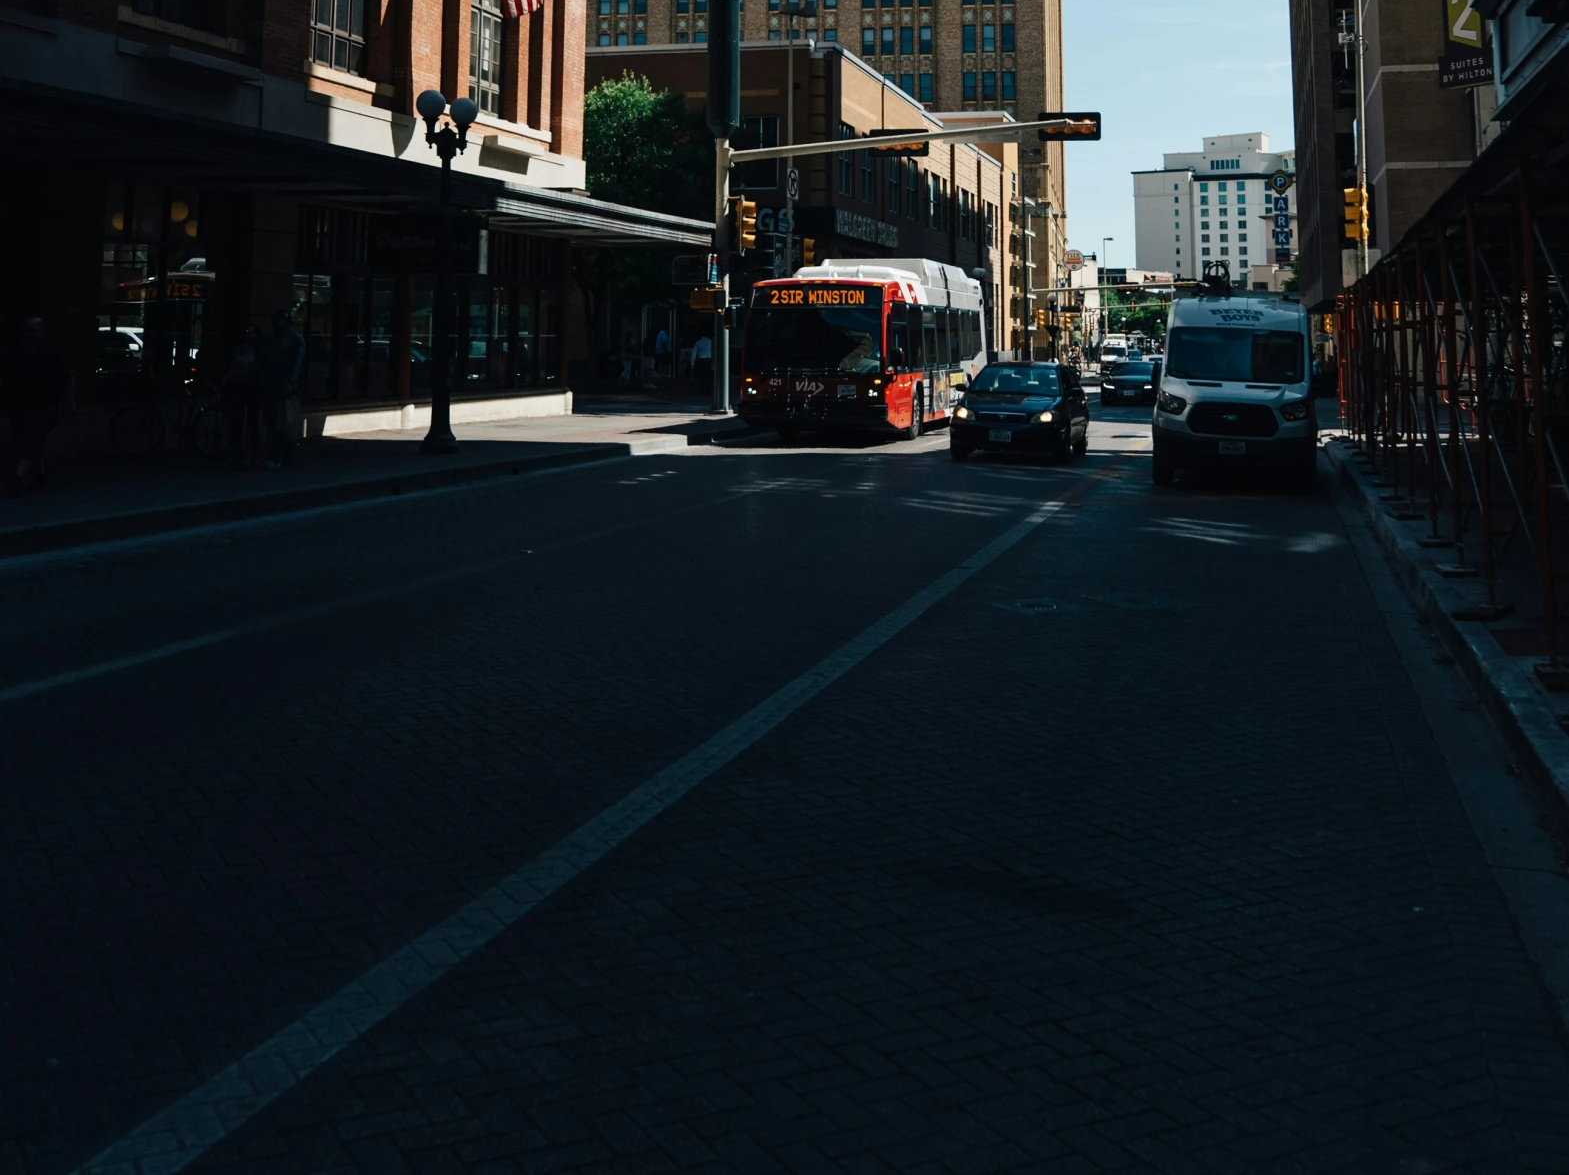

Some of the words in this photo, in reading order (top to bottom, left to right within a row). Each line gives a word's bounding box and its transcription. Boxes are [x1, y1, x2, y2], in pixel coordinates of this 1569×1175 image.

[1450, 57, 1484, 70] SUITES
[1442, 74, 1454, 83] BY
[1458, 67, 1492, 80] HILTON
[808, 290, 865, 305] WINSTON
[1209, 309, 1265, 317] BEYER
[795, 381, 817, 392] VIA
